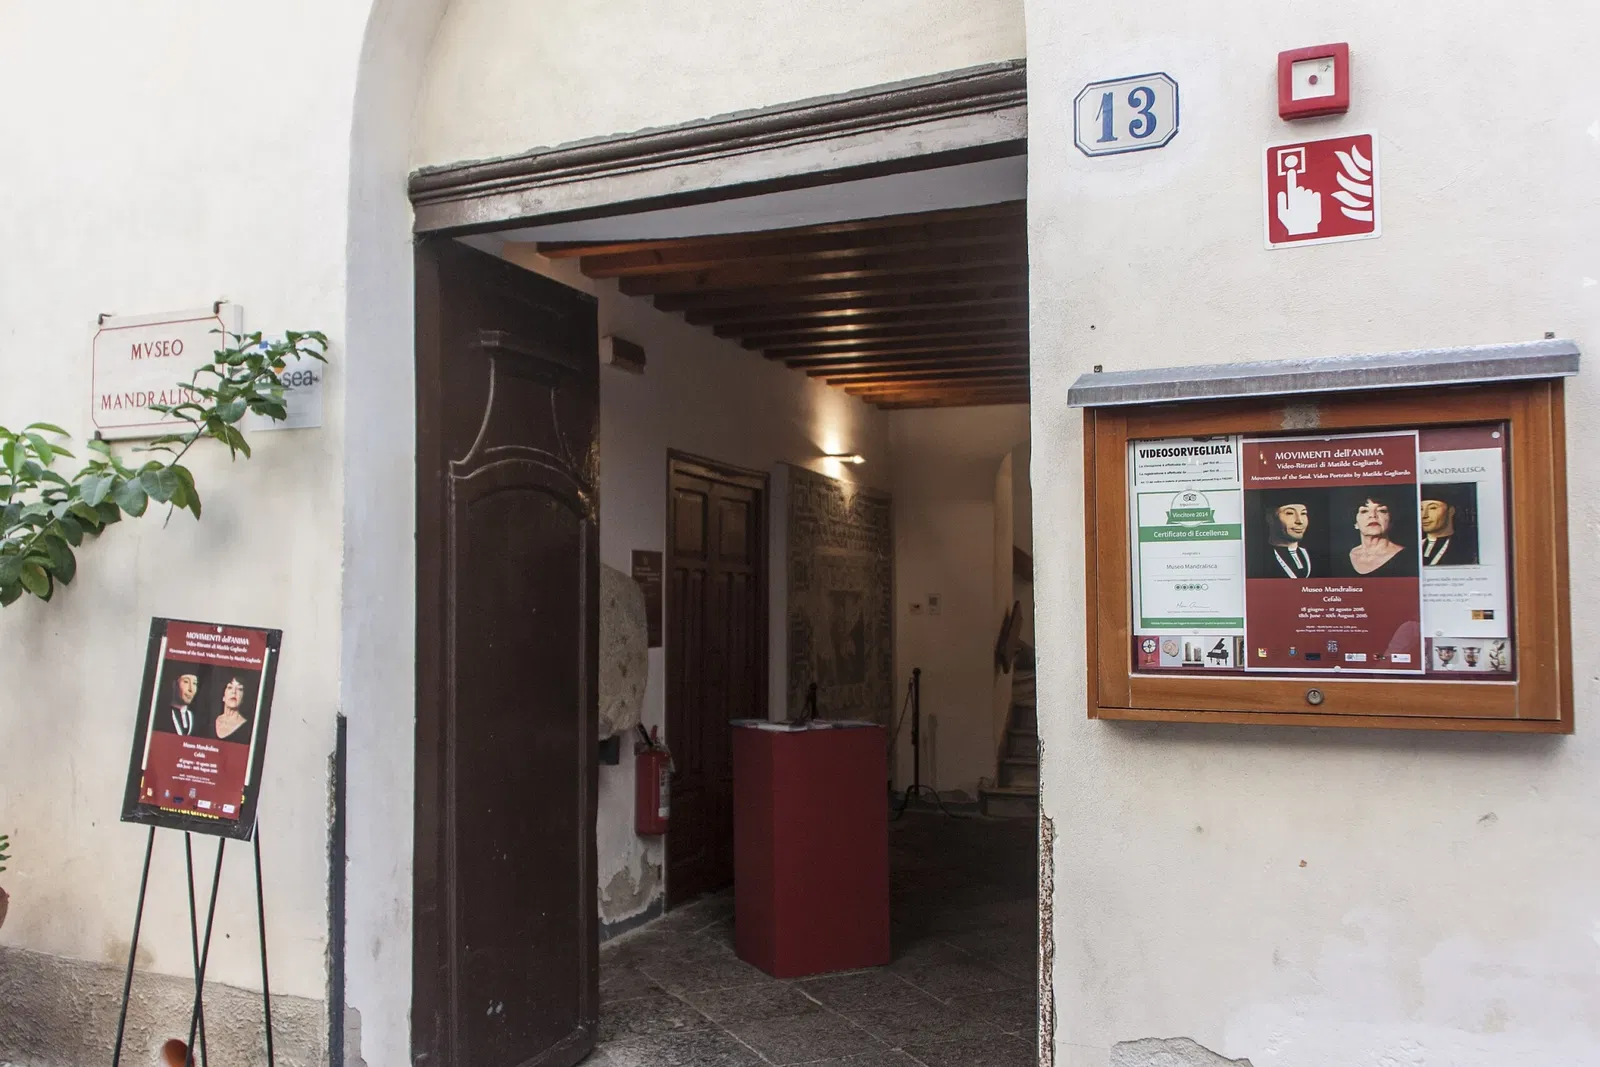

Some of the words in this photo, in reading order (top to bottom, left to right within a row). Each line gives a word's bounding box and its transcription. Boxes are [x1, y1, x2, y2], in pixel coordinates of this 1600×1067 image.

[1095, 87, 1157, 143] 13
[131, 339, 184, 360] MVSEO
[1139, 445, 1232, 458] VIDEOSORVEGLIATA
[1275, 450, 1331, 460] MOVIMENTI
[1334, 448, 1384, 457] dell'ANIMA
[1327, 460, 1351, 468] Matilde
[1352, 459, 1383, 468] Gagliardo
[1362, 470, 1383, 478] Matilde
[1384, 469, 1411, 478] Gagliardo
[1424, 466, 1486, 475] MANDRALISCA
[1153, 530, 1187, 538] Certificato
[1195, 529, 1229, 538] Eccellenza
[1324, 585, 1363, 593] Mandralisca
[186, 632, 221, 642] MOVIMENTI
